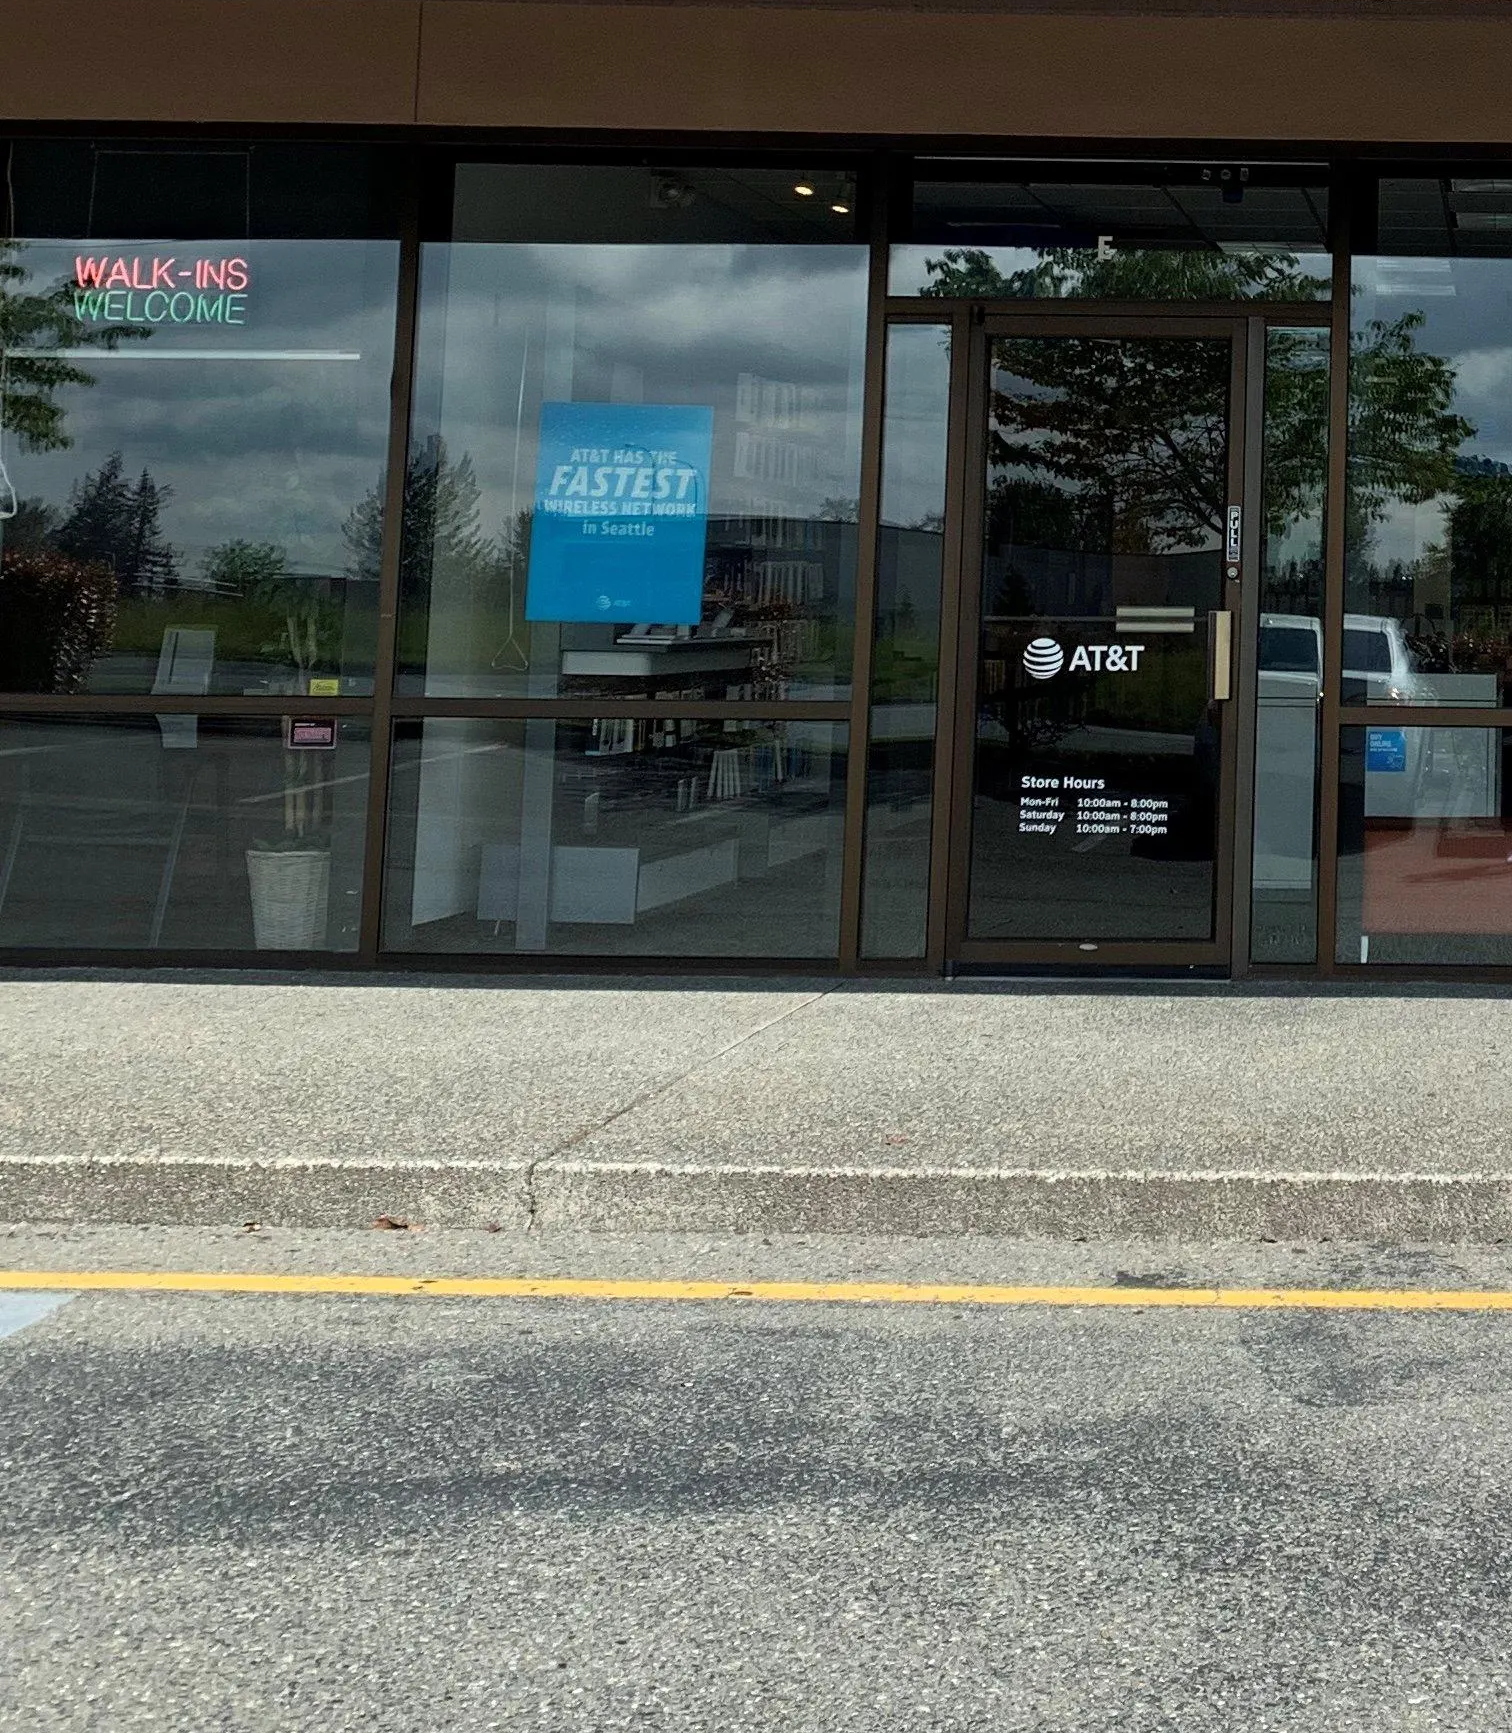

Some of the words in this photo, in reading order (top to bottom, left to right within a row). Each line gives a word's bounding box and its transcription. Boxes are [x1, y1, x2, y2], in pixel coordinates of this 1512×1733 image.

[75, 255, 248, 291] WALK-INS
[74, 290, 248, 324] WELCOME
[570, 448, 610, 464] AT&T
[613, 449, 644, 465] HAS
[650, 451, 678, 466] THE
[550, 465, 698, 500] FASTEST
[544, 499, 619, 516] WIRELESS
[621, 501, 697, 518] NETWORK
[582, 520, 598, 535] in
[601, 520, 656, 537] Seattle
[1229, 511, 1240, 547] PULL
[1068, 644, 1146, 672] AT&T
[1021, 776, 1060, 789] Store
[1063, 776, 1106, 790] Hours
[1020, 797, 1059, 807] Mon-Fri
[1077, 798, 1121, 808] 10:00am
[1130, 799, 1169, 810] 8:00pm
[1019, 809, 1065, 822] Saturday
[1076, 811, 1121, 820] 10:00am
[1129, 812, 1168, 823] 8:00pm
[1018, 823, 1057, 835] Sunday
[1076, 824, 1120, 834] 10:00am
[1130, 824, 1168, 836] 7:00pm
